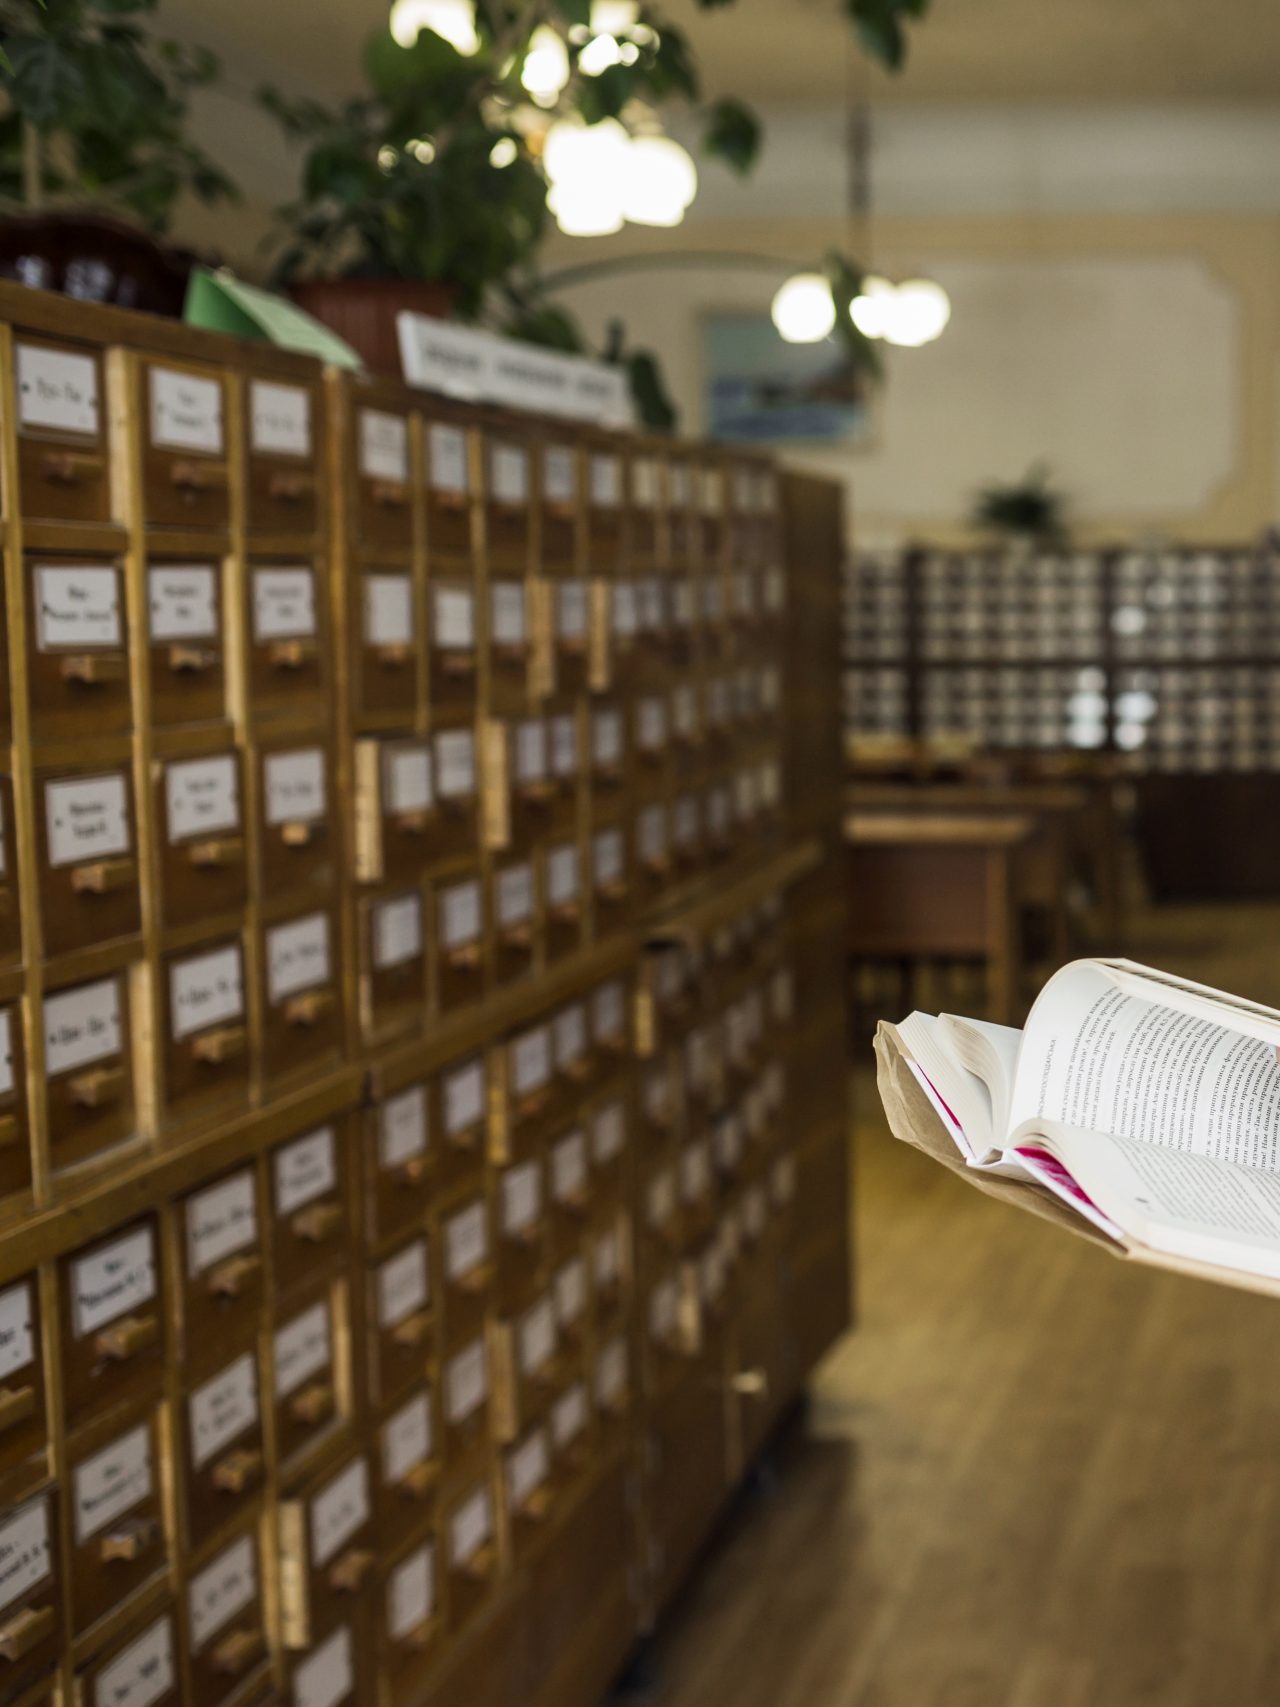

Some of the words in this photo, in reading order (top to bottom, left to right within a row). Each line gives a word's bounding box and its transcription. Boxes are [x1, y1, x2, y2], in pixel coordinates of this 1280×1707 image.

[1240, 1061, 1260, 1100] працювати
[1262, 1104, 1272, 1131] більше
[1268, 1094, 1275, 1103] не
[1274, 1110, 1280, 1120] не
